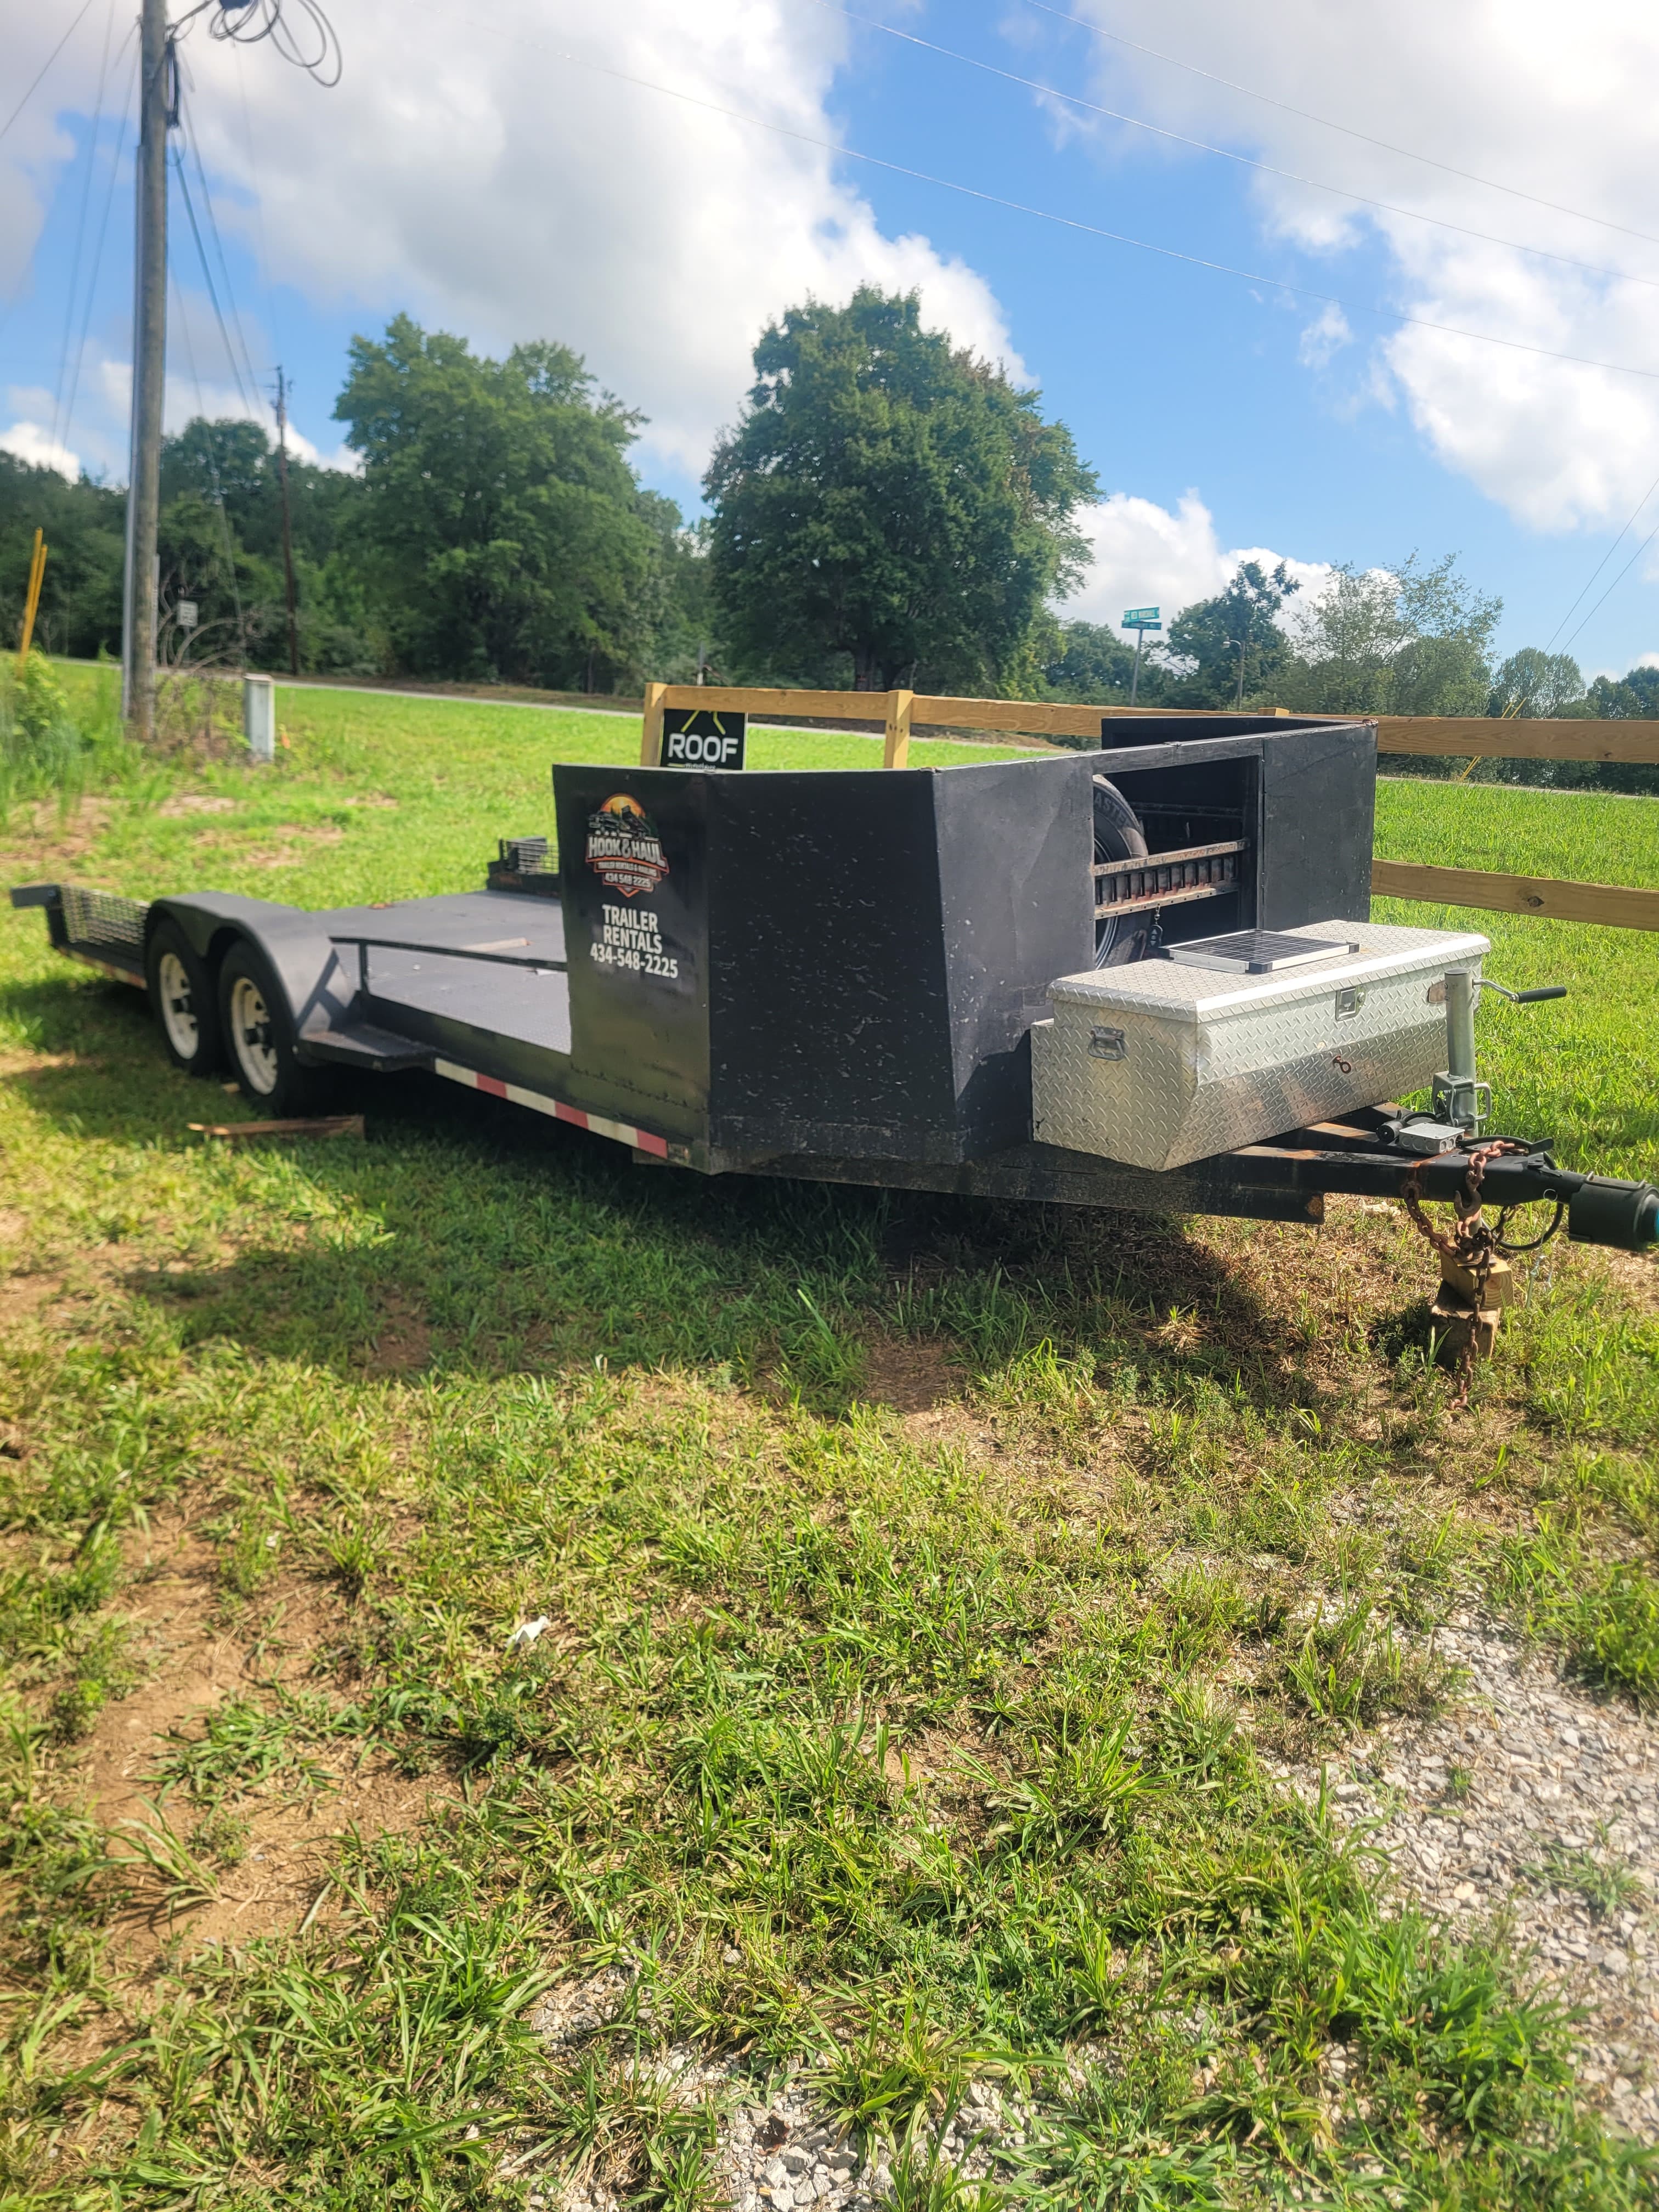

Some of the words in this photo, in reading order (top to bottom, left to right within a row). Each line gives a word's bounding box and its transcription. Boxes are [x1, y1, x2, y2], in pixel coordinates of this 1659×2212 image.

[668, 733, 738, 763] ROOF
[602, 904, 658, 933] TRAILER
[603, 924, 662, 954] RENTALS
[590, 943, 678, 979] 434-548-2225
